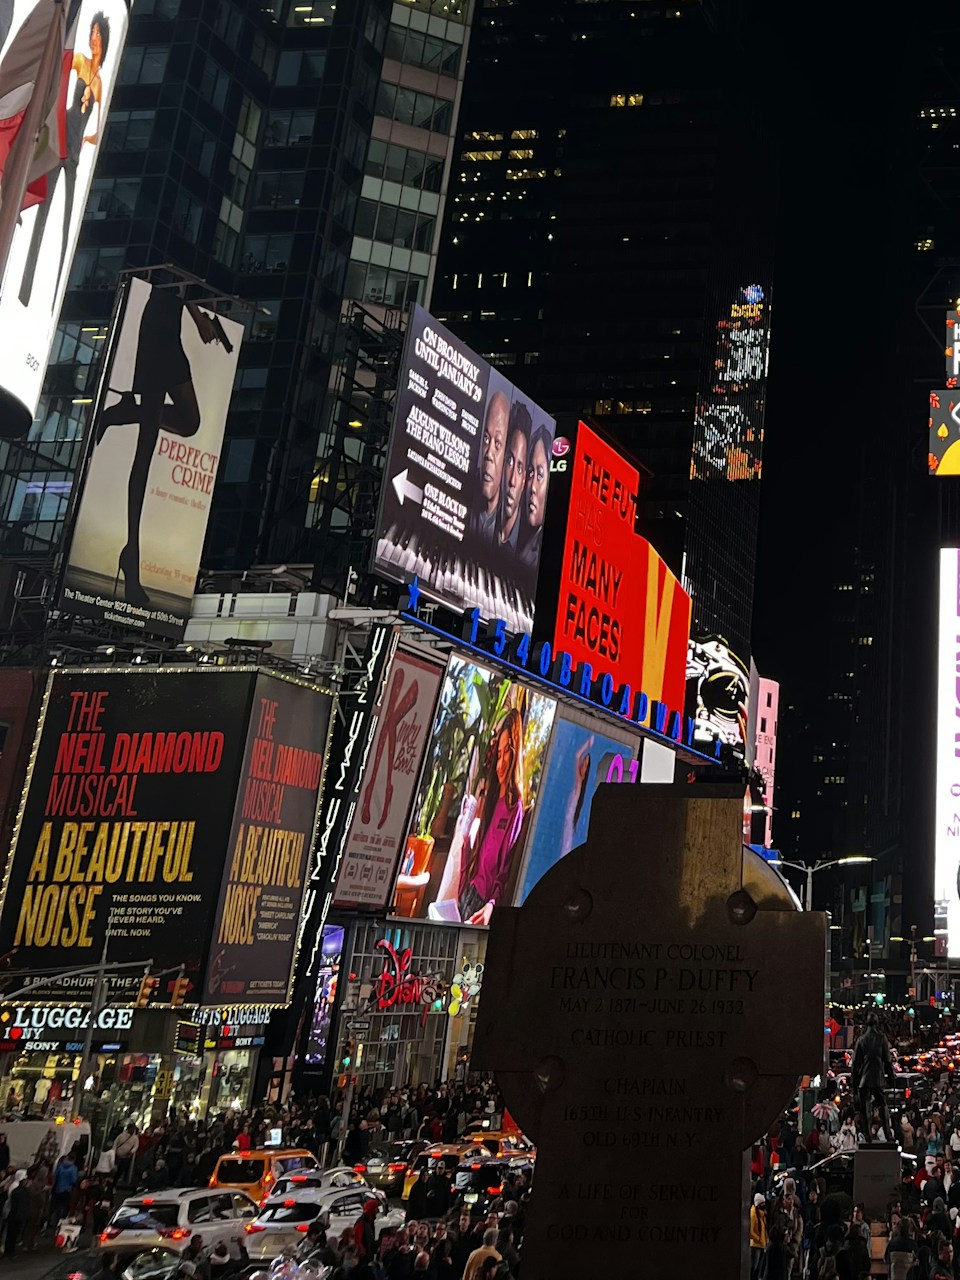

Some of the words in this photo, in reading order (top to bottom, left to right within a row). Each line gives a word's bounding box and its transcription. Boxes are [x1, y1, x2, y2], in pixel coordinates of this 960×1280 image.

[415, 338, 440, 371] UNTIL
[437, 357, 475, 398] JANUARY
[472, 384, 482, 402] 29
[423, 326, 437, 349] ON
[436, 335, 480, 382] BROADWAY
[405, 418, 421, 441] THE
[421, 428, 445, 456] PIANO
[444, 440, 470, 474] LESSON
[409, 404, 440, 436] AUGUST
[439, 424, 471, 458] WILSON'S
[158, 436, 219, 474] PERFECT
[550, 459, 567, 472] LG
[171, 464, 214, 495] CRIME
[583, 453, 611, 505] THE
[424, 483, 438, 501] ONE
[437, 489, 459, 513] BLOCK
[458, 501, 467, 519] UP
[569, 538, 624, 610] MANY
[64, 588, 75, 599] The
[75, 590, 96, 605] Theater
[95, 596, 115, 610] Center
[126, 605, 152, 620] Broadway
[562, 591, 622, 664] FACES
[469, 606, 551, 676] 1540
[558, 652, 696, 747] BROADWAY
[67, 691, 109, 732] THE
[257, 698, 279, 739] THE
[54, 733, 106, 774] NEIL
[109, 731, 225, 774] DIAMOND
[249, 737, 275, 780] NEIL
[272, 743, 322, 791] DIAMOND
[45, 775, 138, 817] MUSICAL
[242, 777, 285, 824] MUSICAL
[27, 821, 53, 882] A
[52, 820, 196, 883] BEAUTIFUL
[228, 823, 245, 882] A
[239, 825, 305, 888] BEAUTIFUL
[110, 907, 126, 915] THE
[127, 907, 153, 915] STORY
[153, 906, 183, 915] YOU'VE
[112, 894, 128, 902] THE
[129, 894, 157, 903] SONGS
[158, 894, 175, 902] YOU
[218, 884, 262, 945] NOISE
[13, 884, 104, 948] NOISE
[105, 928, 129, 937] UNTIL
[107, 916, 134, 924] NEVER
[566, 942, 662, 961] LIEUTENANT
[667, 944, 745, 962] COLONEL
[550, 966, 646, 990] FRANCIS
[678, 968, 760, 992] DUFFY
[13, 1008, 135, 1029] LUGGAGE
[227, 1008, 273, 1025] LUGGAGE
[560, 997, 589, 1014] MAY
[594, 998, 603, 1013] 2
[690, 999, 707, 1015] 26
[712, 999, 745, 1016] 1932
[25, 1041, 59, 1051] SONY
[235, 1037, 252, 1047] SONY
[571, 1029, 657, 1048] CATHOLIC
[665, 1030, 729, 1049] PRIEST
[603, 1078, 687, 1097] CHAPLAIN
[649, 1106, 725, 1124] INFANTRY
[583, 1131, 617, 1148] OLD
[577, 1183, 611, 1200] LIFE
[648, 1183, 719, 1202] SERVICE
[637, 1225, 723, 1246] COUNTRY
